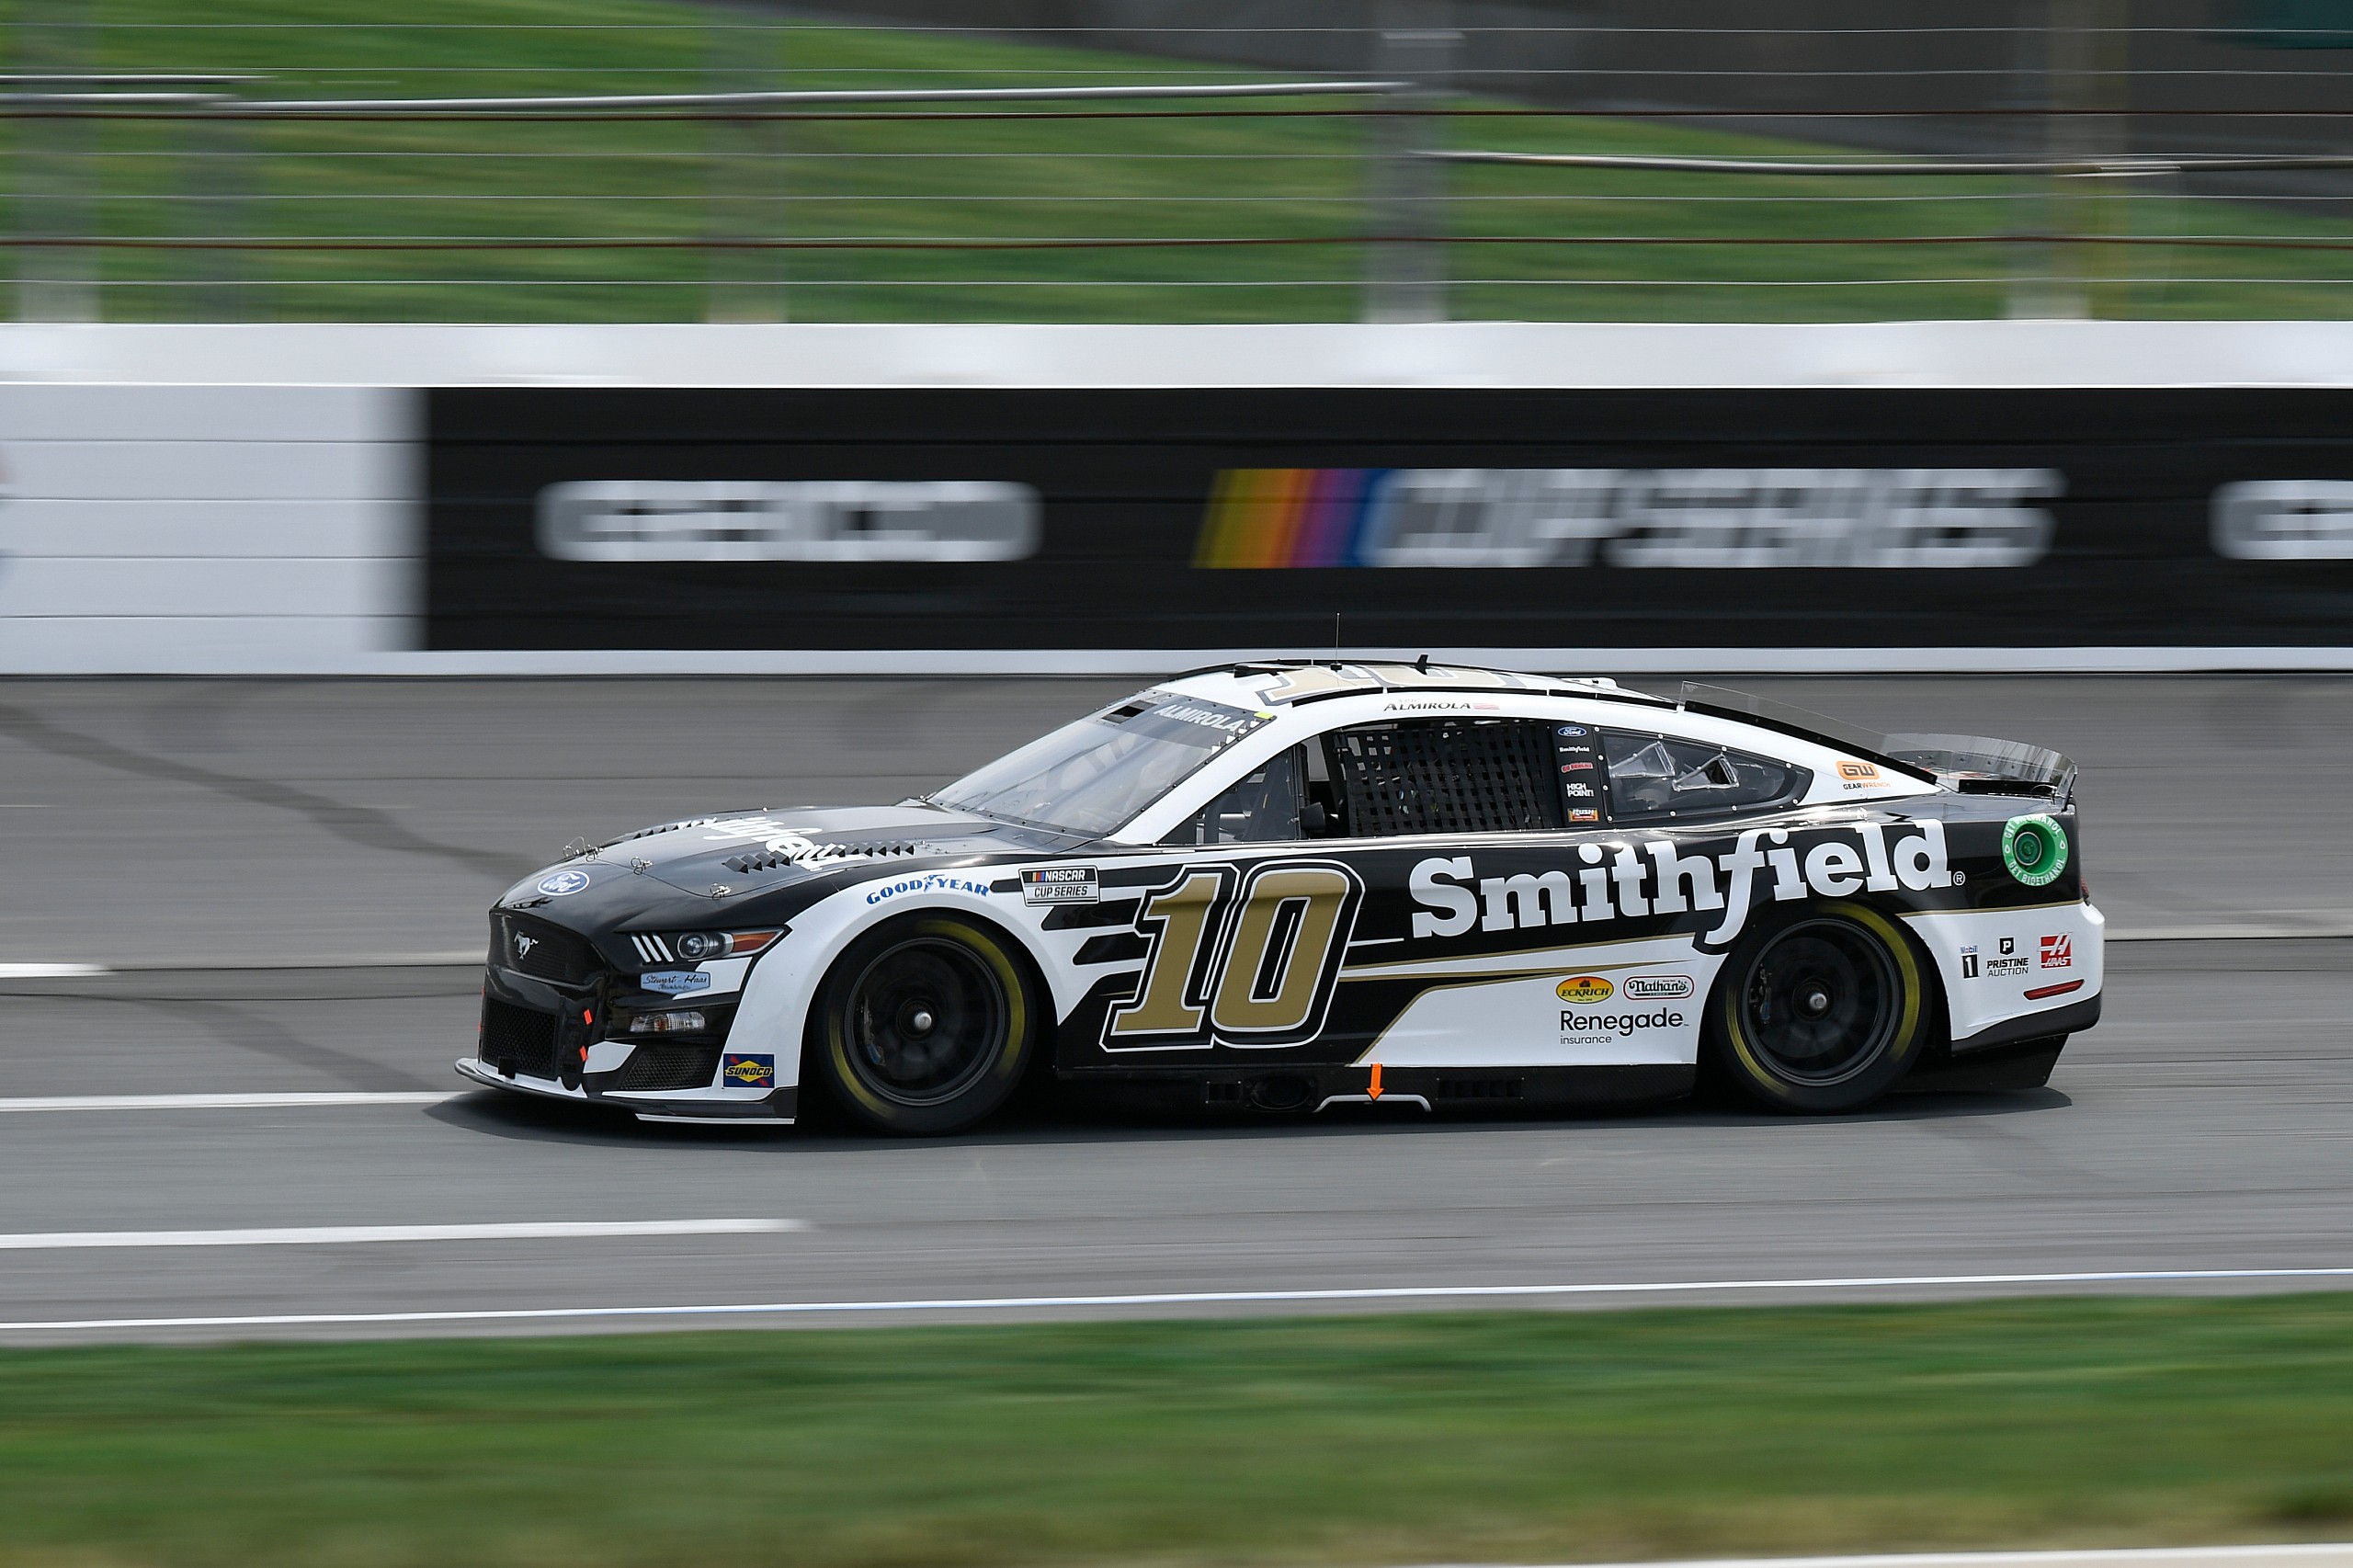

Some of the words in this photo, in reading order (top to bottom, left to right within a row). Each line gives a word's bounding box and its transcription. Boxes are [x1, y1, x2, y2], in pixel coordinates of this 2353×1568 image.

[1383, 702, 1472, 711] ALMIROLA
[1154, 704, 1245, 732] ALMIROLA
[1566, 782, 1587, 790] HIGH
[1045, 870, 1086, 881] NASCAR
[2007, 860, 2023, 878] GET
[2021, 857, 2067, 886] BIOETHANOL
[1034, 887, 1053, 897] CUP
[1054, 886, 1088, 897] SERIES
[1110, 867, 1350, 1035] 10
[1986, 958, 2029, 970] PRISTINE
[1987, 966, 2029, 978] AUCTION
[1629, 979, 1688, 993] Nathan's
[1562, 987, 1609, 998] ECKRICH
[1561, 1007, 1684, 1037] Renegade
[1560, 1035, 1612, 1045] insurance
[726, 1066, 771, 1076] SUNOCO
